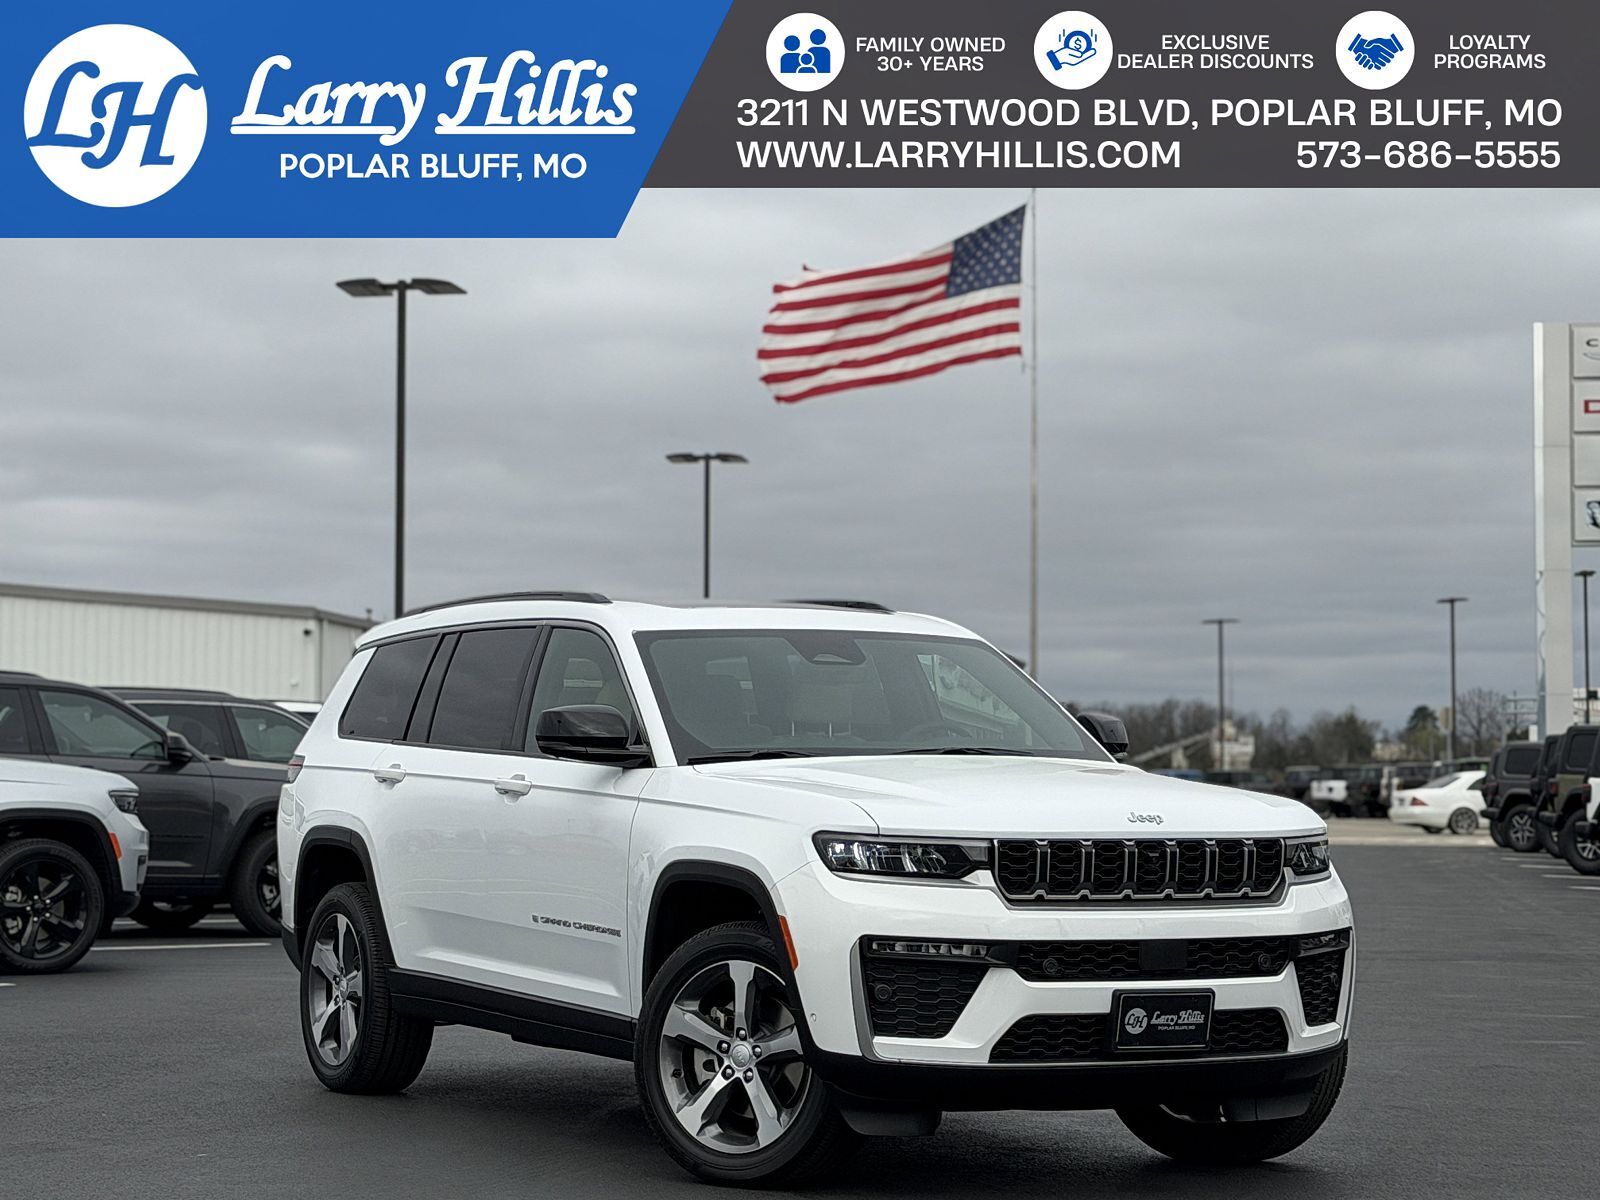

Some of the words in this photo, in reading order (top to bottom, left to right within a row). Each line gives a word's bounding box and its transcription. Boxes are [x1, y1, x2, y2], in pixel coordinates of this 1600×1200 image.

[1127, 811, 1164, 825] Jeep
[1150, 1011, 1177, 1025] Larry
[1178, 1010, 1205, 1023] Hillis
